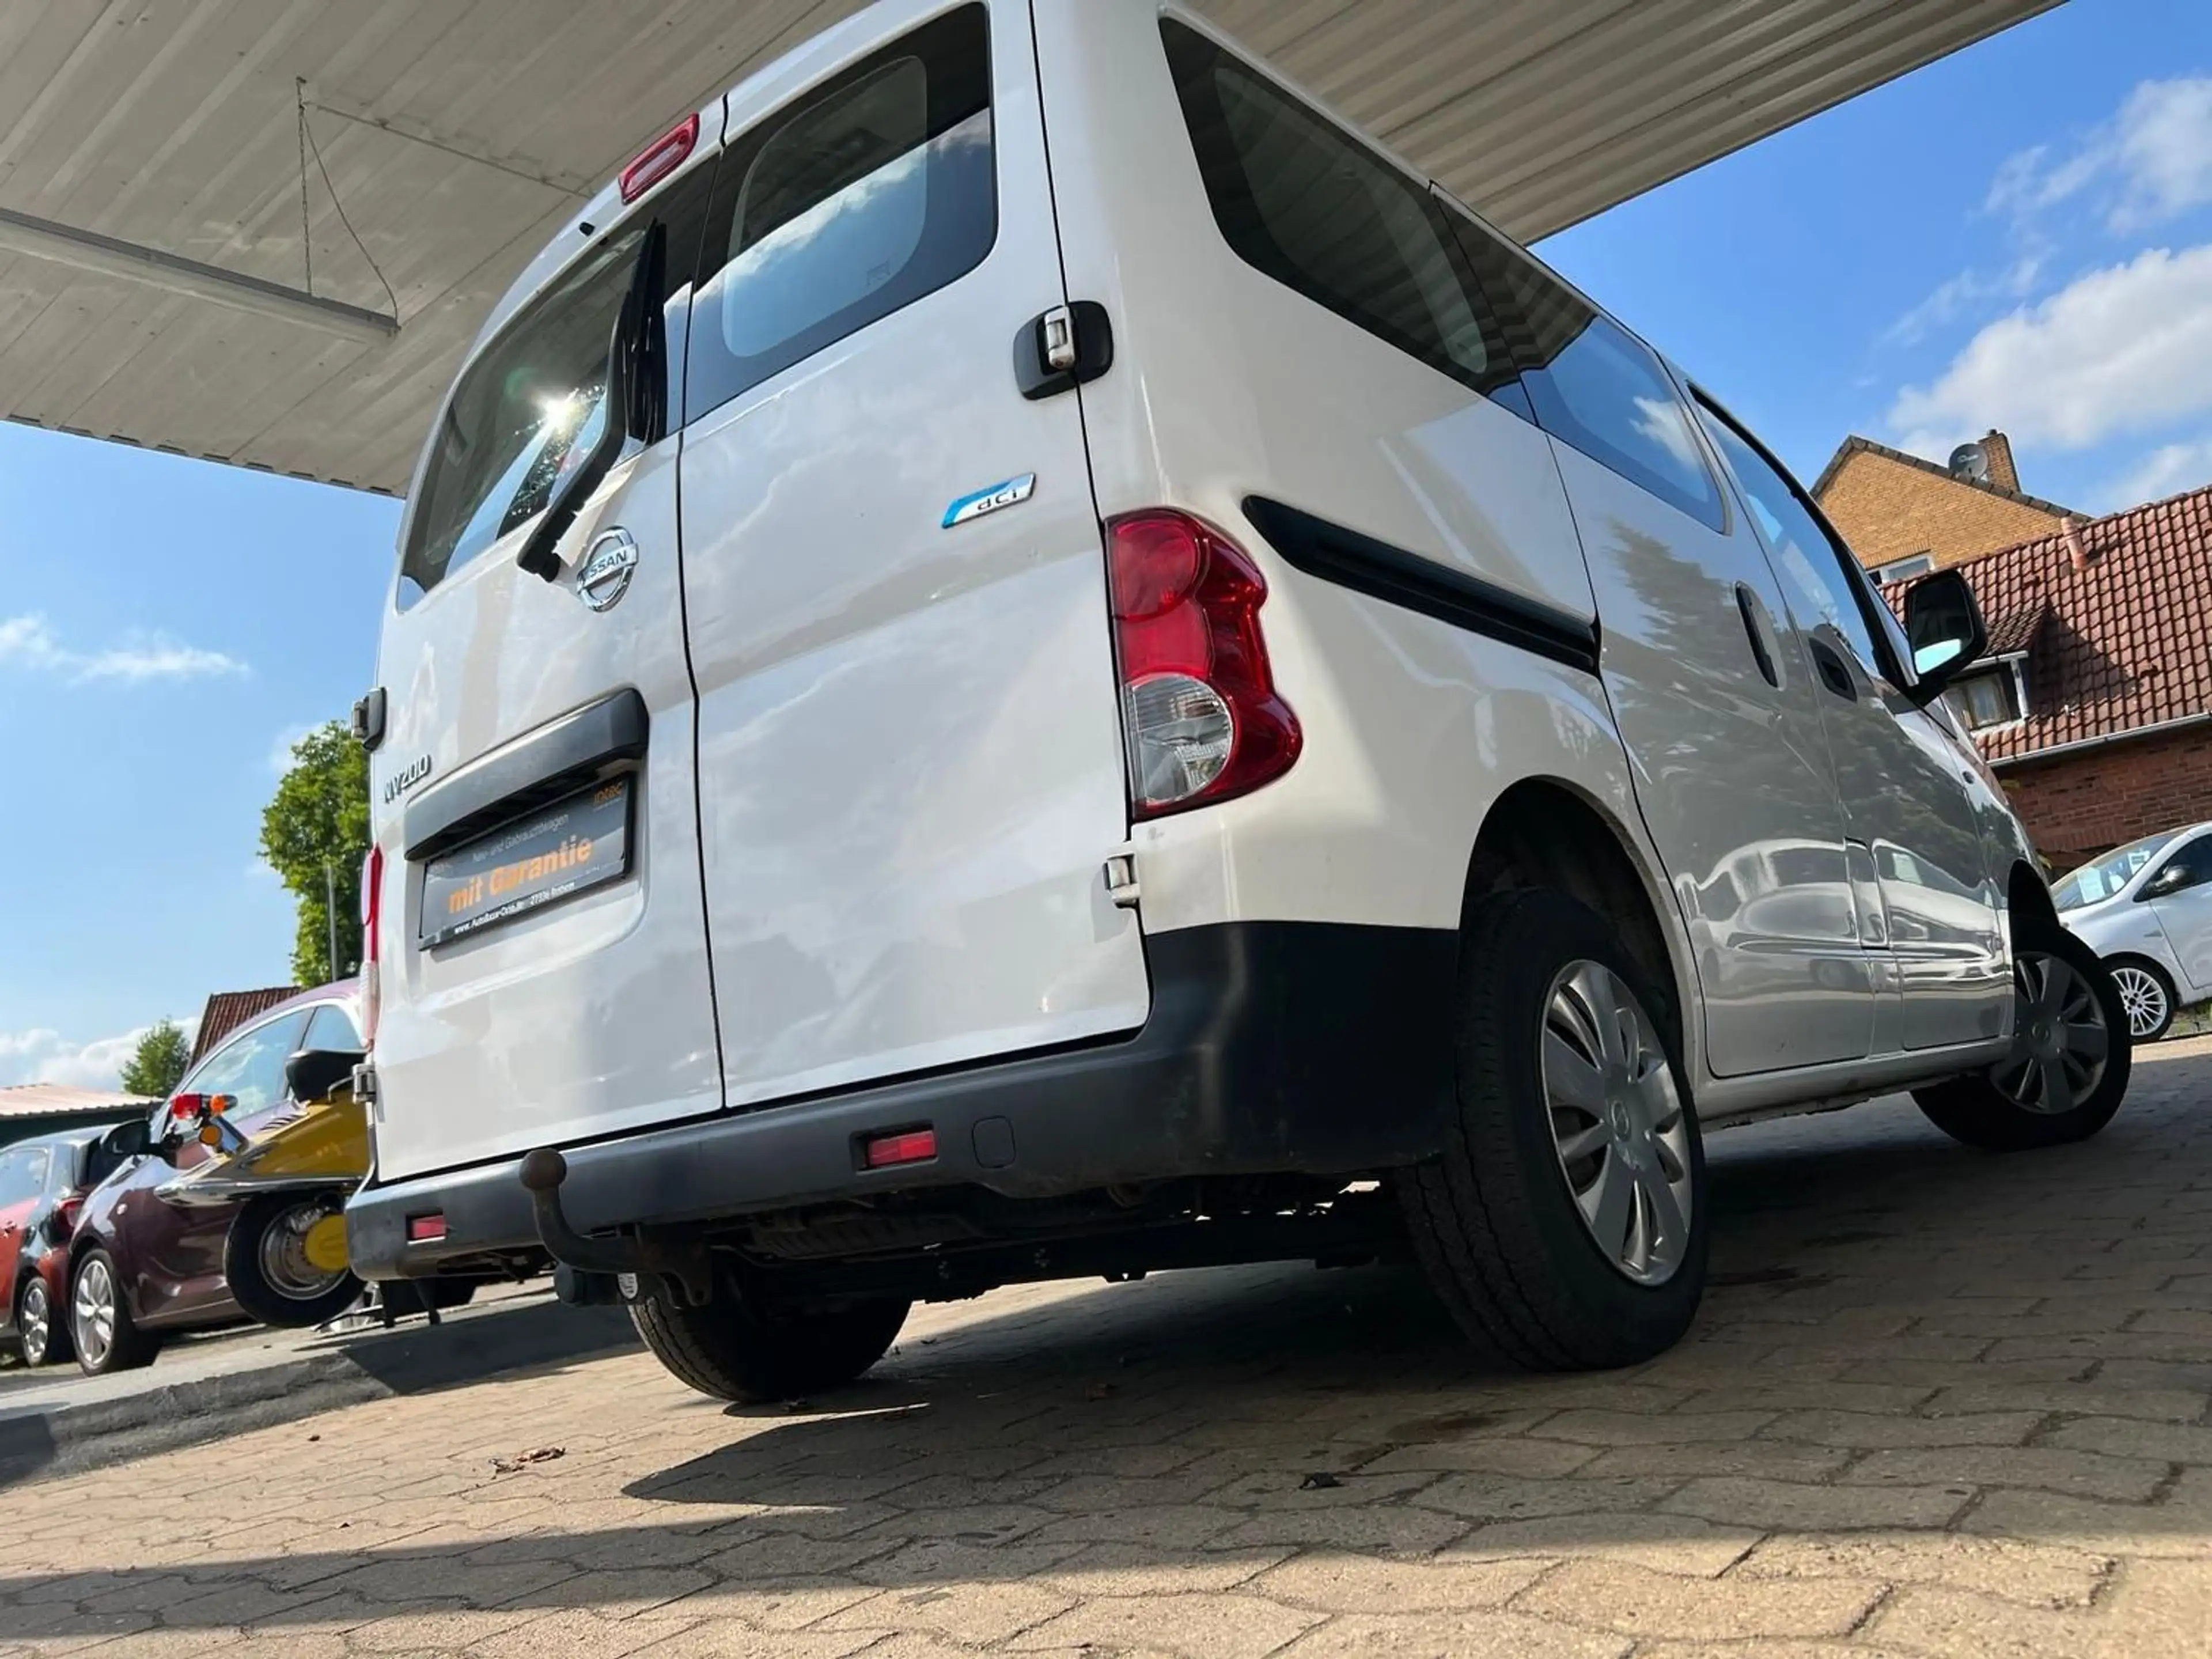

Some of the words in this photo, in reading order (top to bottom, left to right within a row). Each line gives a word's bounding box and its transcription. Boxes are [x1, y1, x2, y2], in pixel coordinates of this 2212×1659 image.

[384, 754, 432, 804] NV200
[449, 875, 483, 914] mit
[490, 835, 593, 896] Garantie
